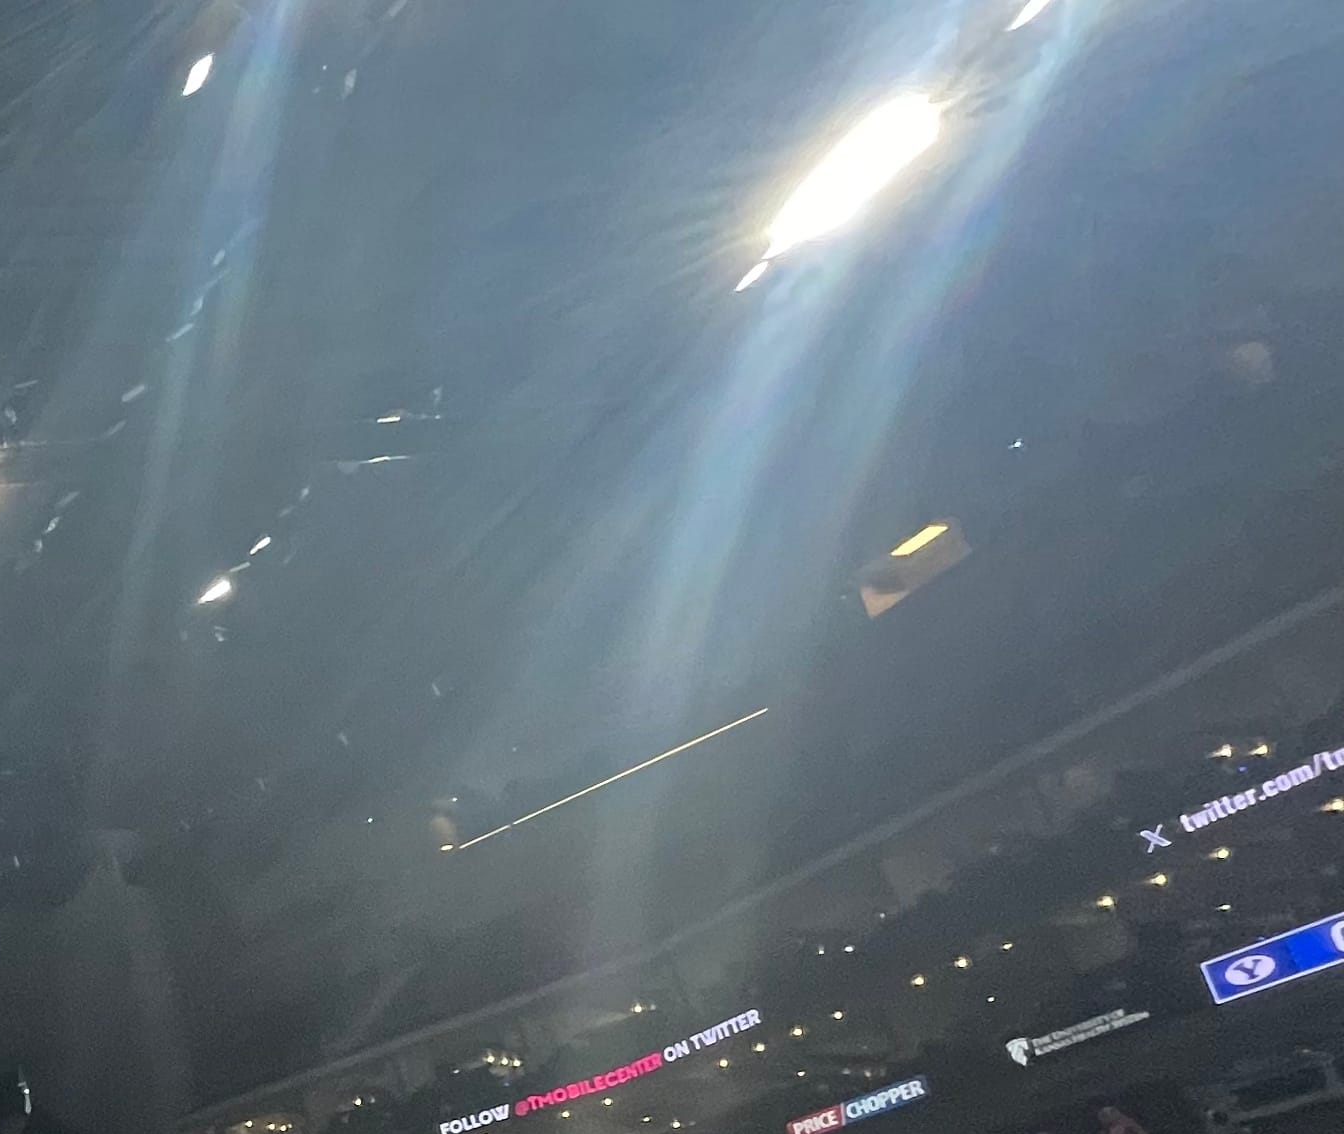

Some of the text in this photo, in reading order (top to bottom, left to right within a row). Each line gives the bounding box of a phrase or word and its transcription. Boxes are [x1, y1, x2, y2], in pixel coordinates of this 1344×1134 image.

[514, 1051, 663, 1117] @TMOBILECENTER
[663, 1039, 691, 1063] ON
[690, 1008, 762, 1051] TWITTER
[846, 1080, 925, 1119] CHOPPER
